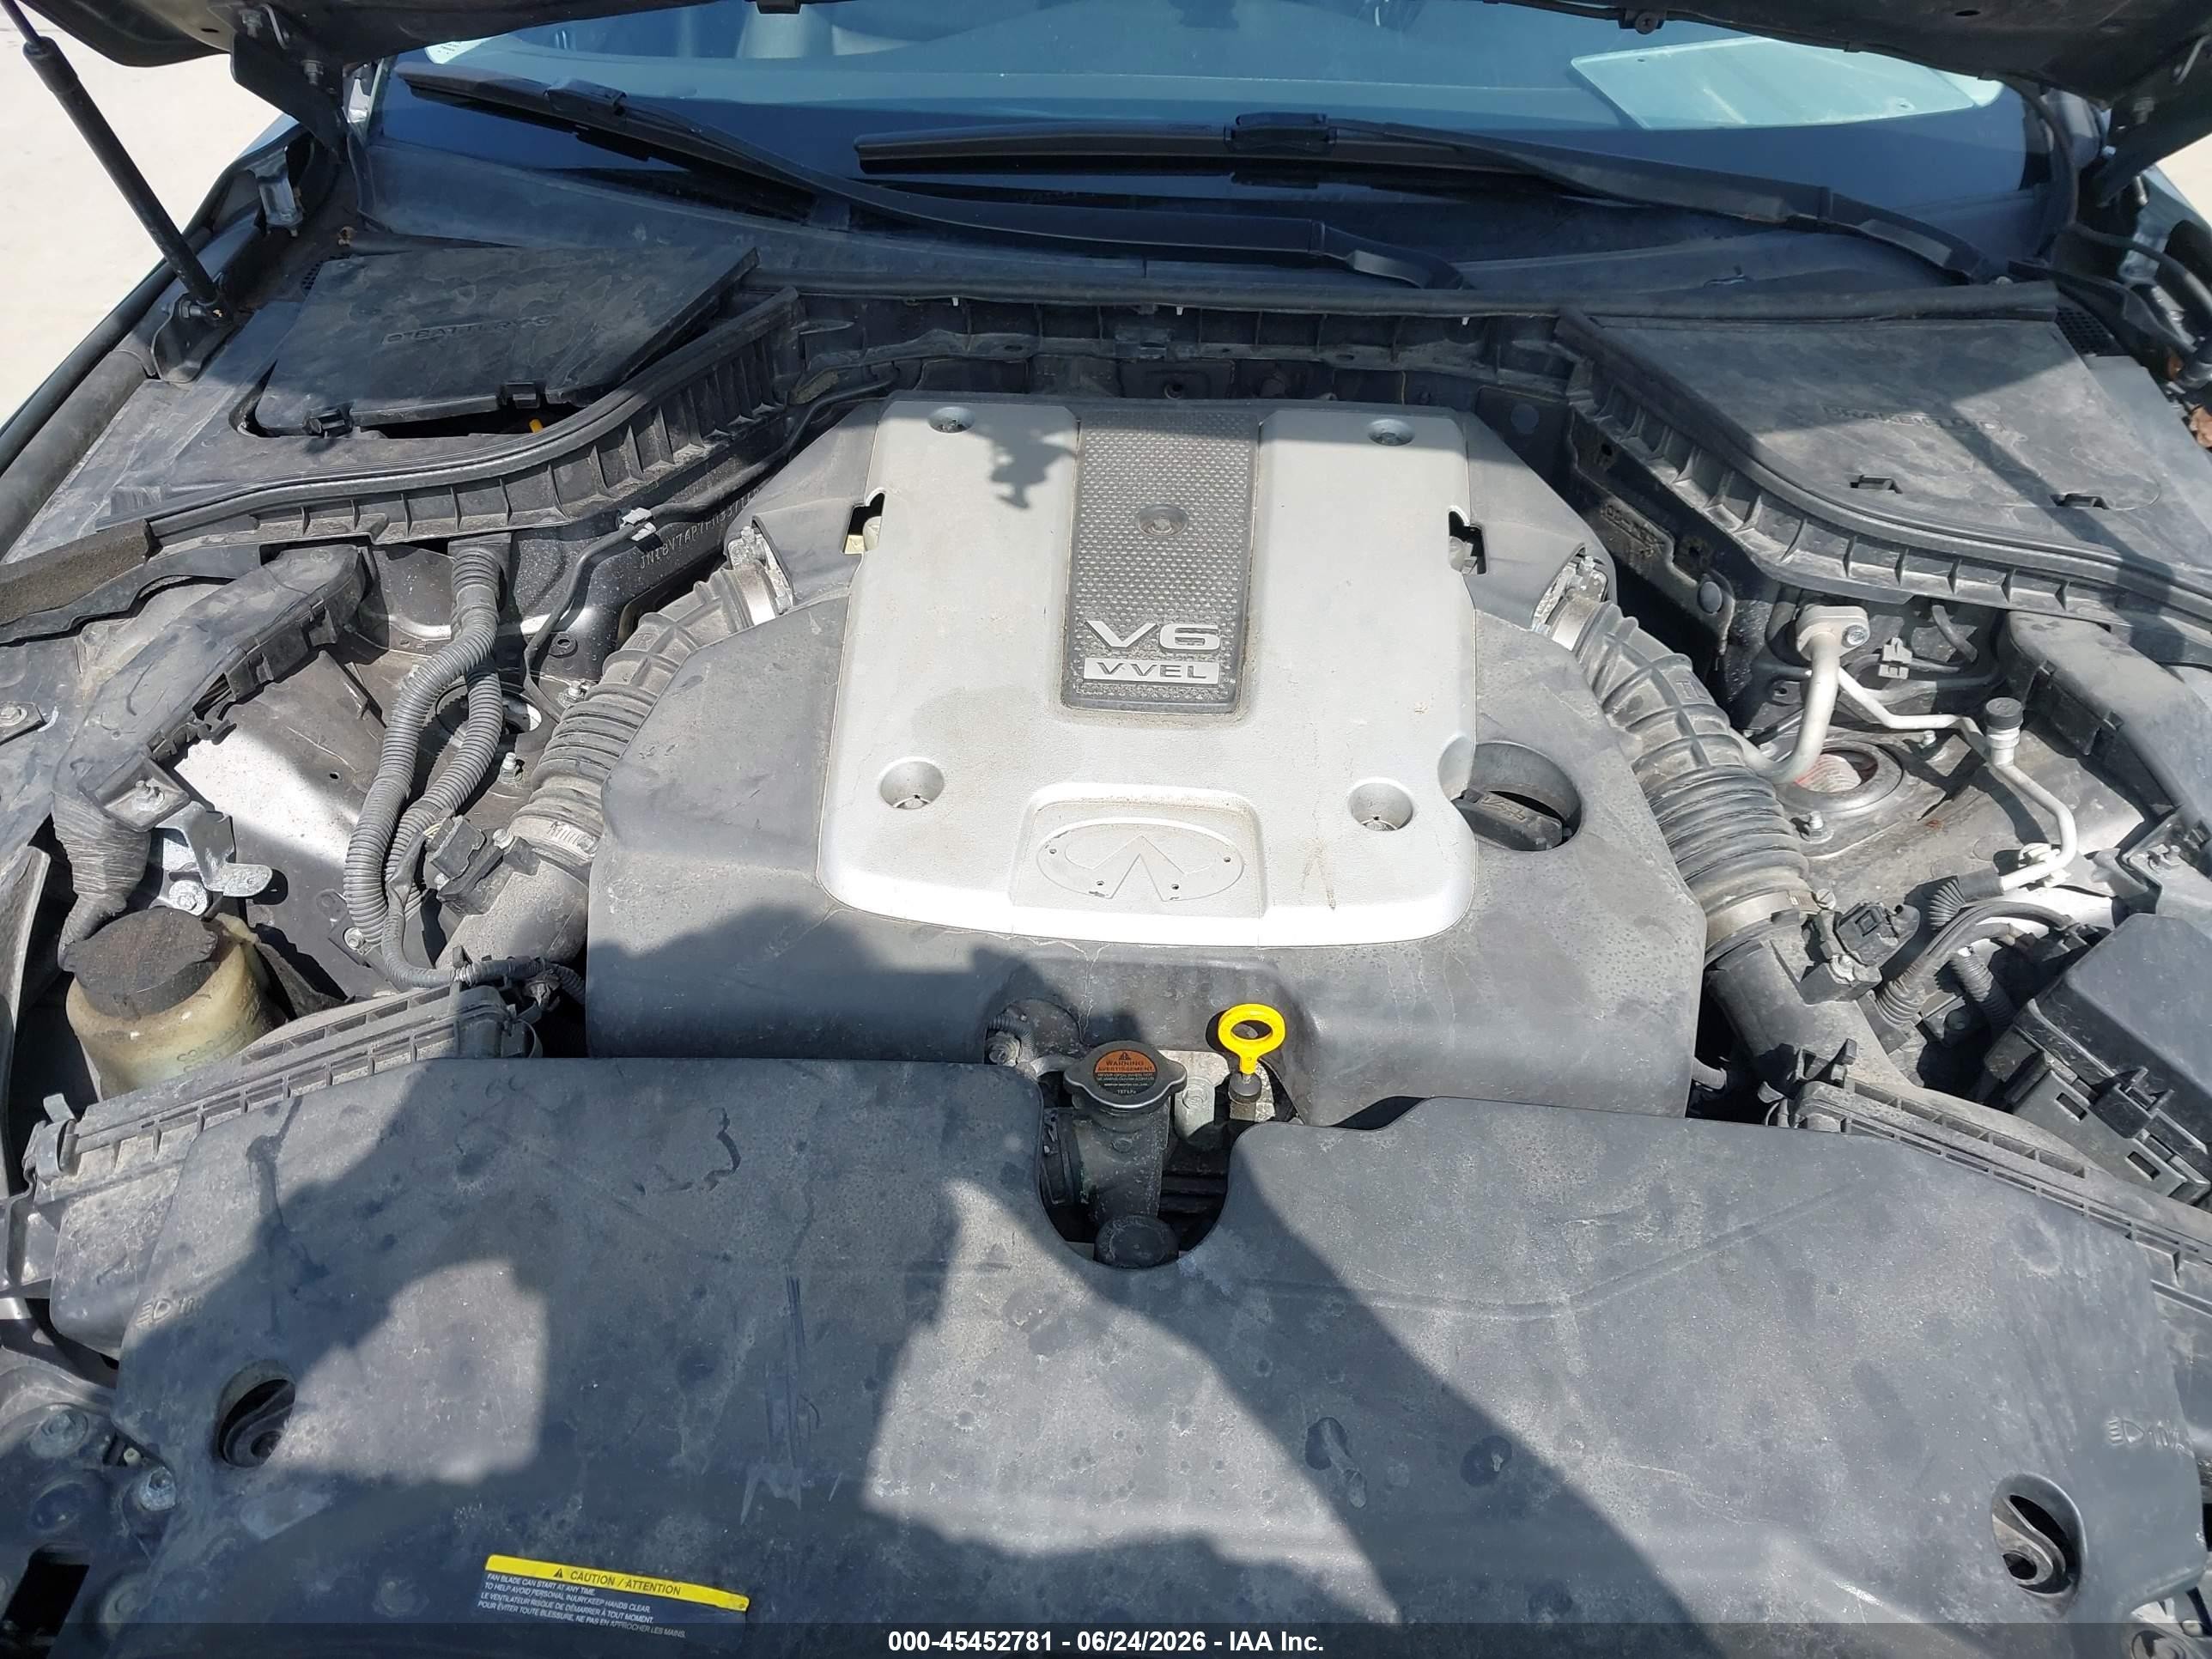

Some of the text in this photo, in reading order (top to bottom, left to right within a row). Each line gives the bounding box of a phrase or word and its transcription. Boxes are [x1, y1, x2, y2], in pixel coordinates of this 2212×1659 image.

[1085, 620, 1221, 652] V6
[1097, 661, 1207, 679] VVEL
[487, 1573, 501, 1582] FAN
[500, 1575, 520, 1584] BLADE
[521, 1578, 537, 1587] CAN
[537, 1580, 556, 1589] START
[566, 1584, 580, 1593] ANY
[493, 1583, 511, 1592] HELP
[511, 1586, 531, 1595] AVOID
[531, 1589, 565, 1601] PERSONAL
[605, 1601, 628, 1609] HANDS
[570, 1571, 616, 1586] CAUTION
[625, 1579, 681, 1595] ATTENTION
[477, 1600, 496, 1610] POUR
[496, 1601, 519, 1613] ÉVITER
[519, 1606, 538, 1616] TOUTE
[575, 1614, 585, 1623] NE
[586, 1616, 599, 1625] PAS
[599, 1618, 610, 1626] EN
[610, 1620, 651, 1633] APPROCHER
[651, 1625, 664, 1634] LES
[481, 1591, 654, 1624] LE VENTILATEUR RISQUE DE DÉMARRER À TOUT MOMENT.
